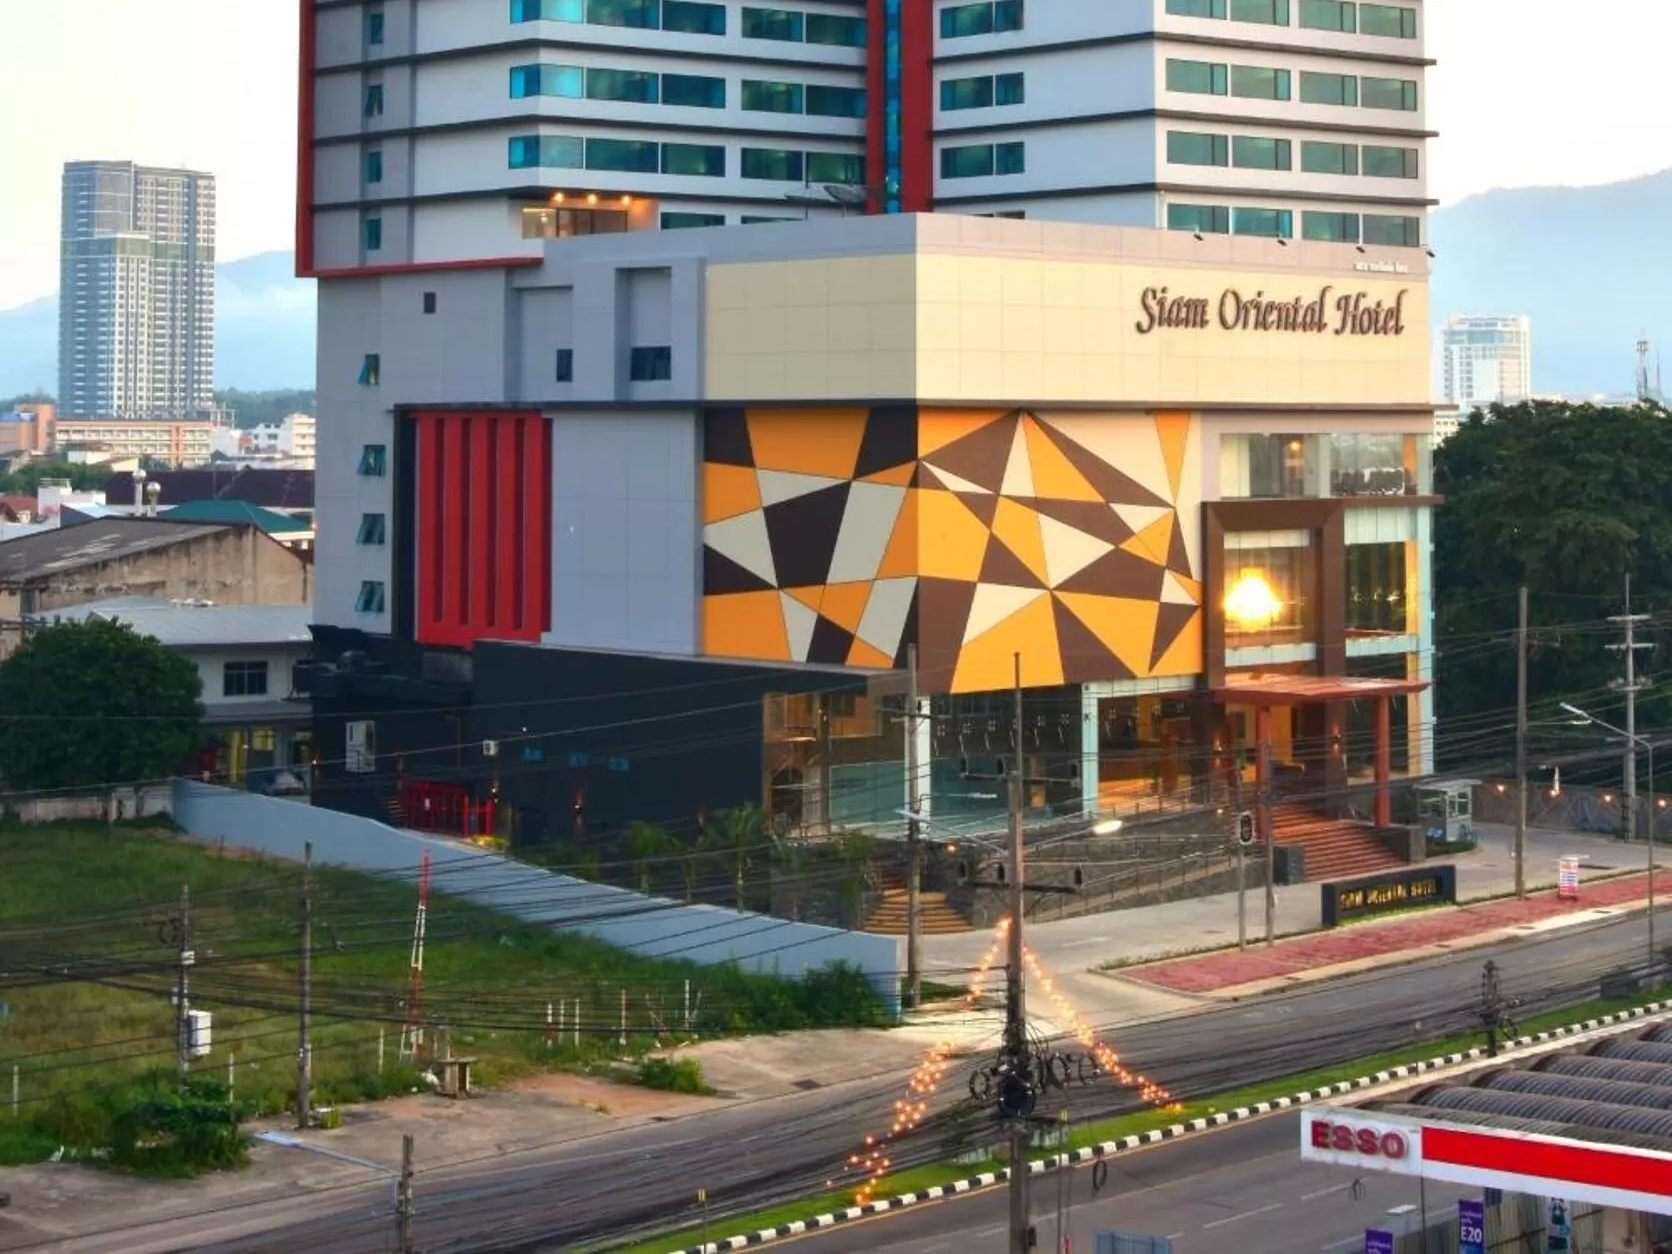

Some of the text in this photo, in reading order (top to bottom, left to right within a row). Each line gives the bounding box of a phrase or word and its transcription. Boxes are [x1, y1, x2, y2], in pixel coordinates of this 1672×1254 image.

[1135, 285, 1408, 336] Siam Oriental Hotel
[1461, 1225, 1483, 1244] E20
